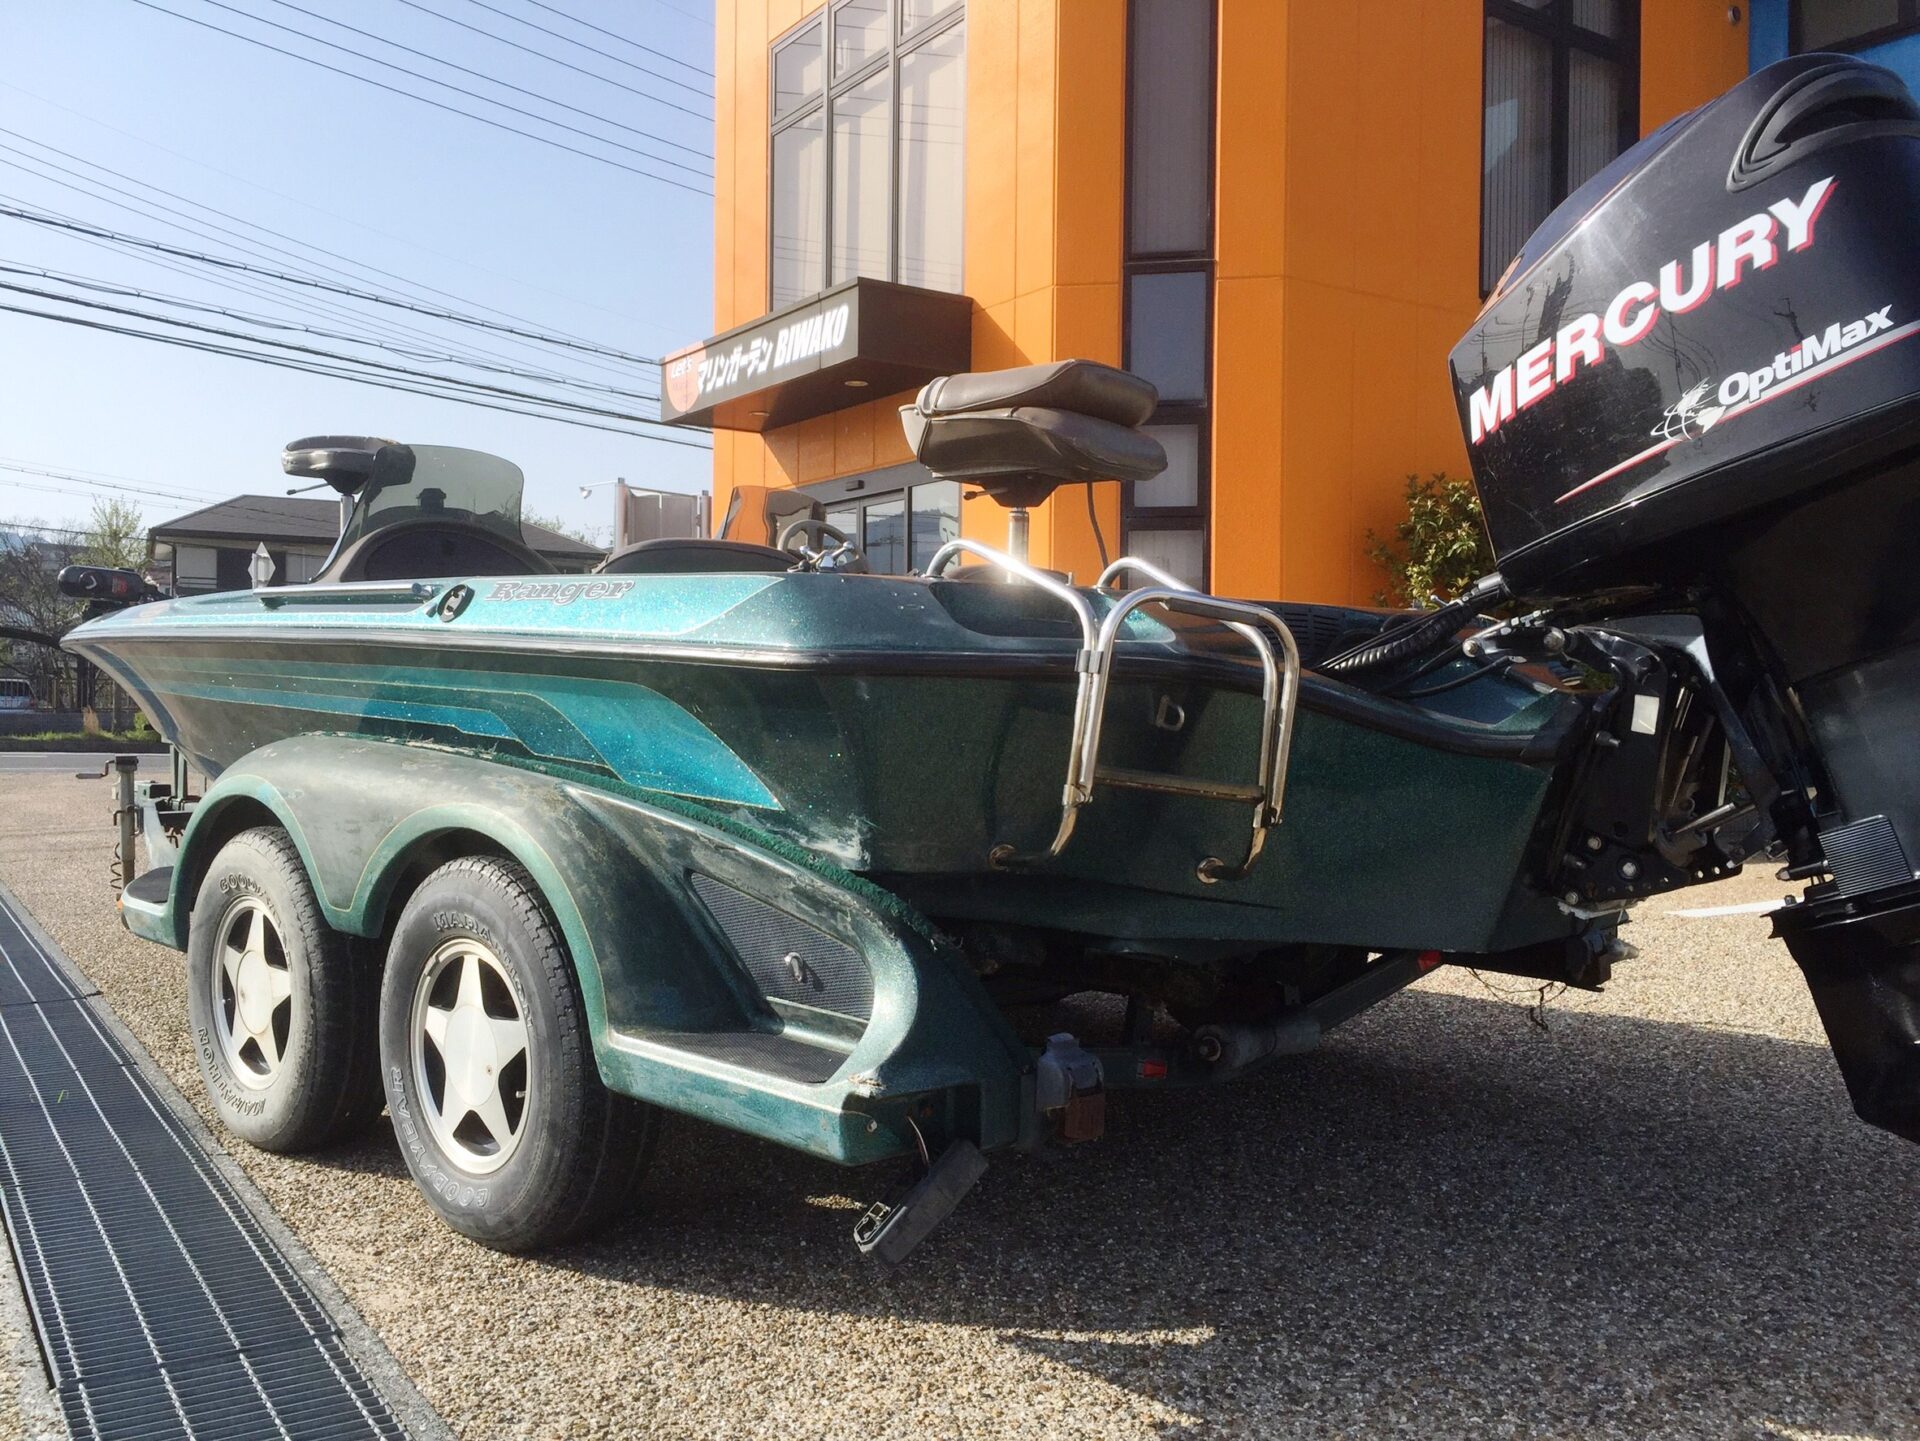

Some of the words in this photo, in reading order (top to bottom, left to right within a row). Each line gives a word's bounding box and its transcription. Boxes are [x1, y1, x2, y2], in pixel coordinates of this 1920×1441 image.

[698, 336, 774, 394] マリンガーデン
[773, 304, 850, 369] BIWAKO
[1469, 175, 1839, 446] MERCURY
[1717, 303, 1895, 407] OptiMax
[485, 580, 636, 606] Ranger
[390, 1065, 489, 1208] GOODYEAR
